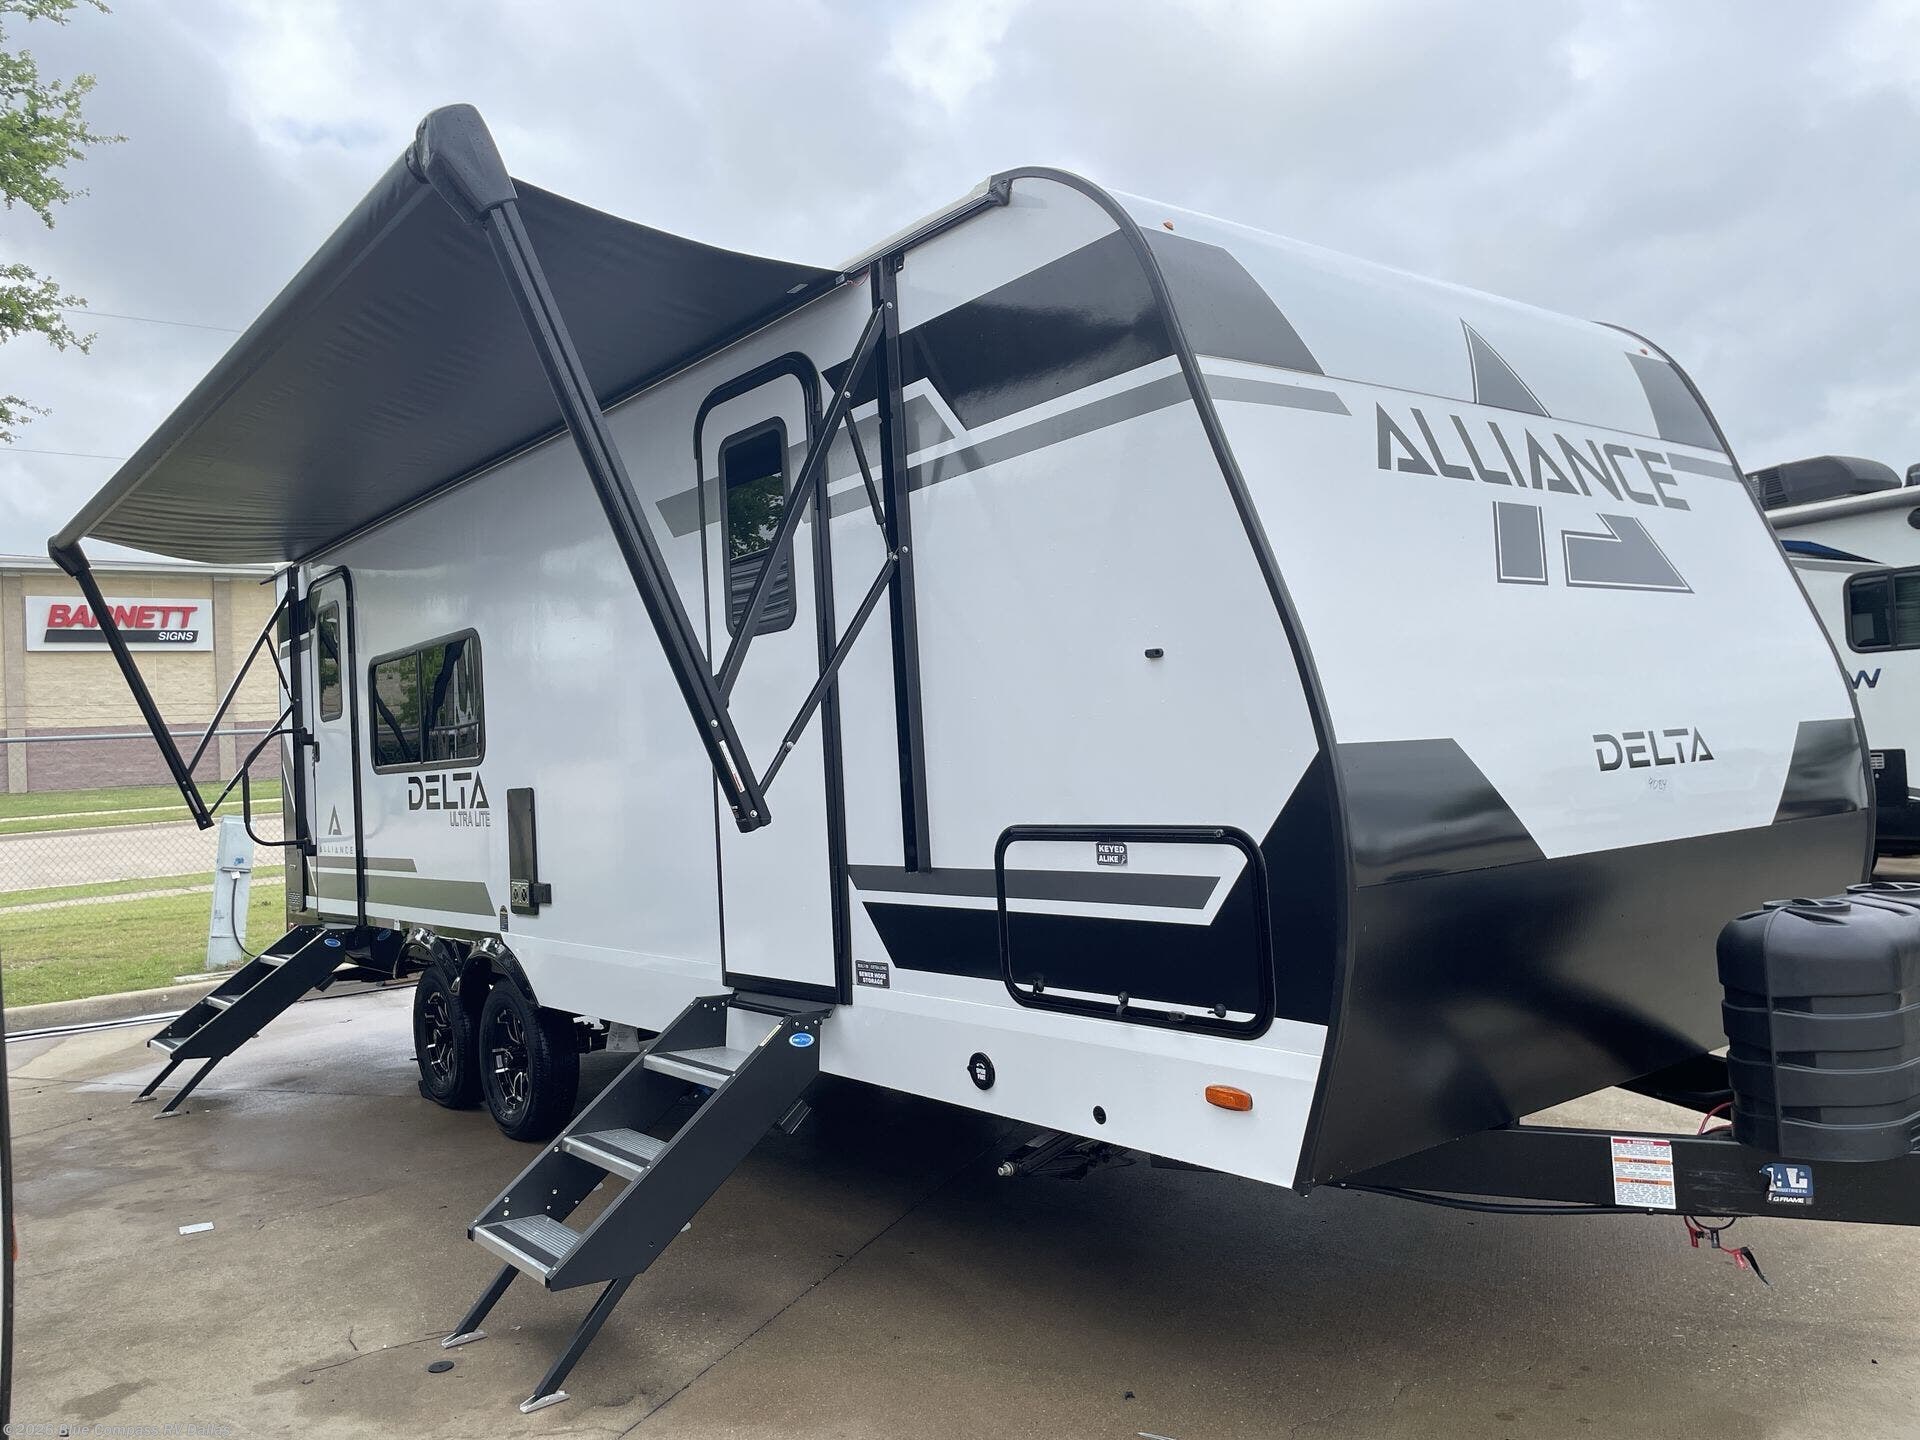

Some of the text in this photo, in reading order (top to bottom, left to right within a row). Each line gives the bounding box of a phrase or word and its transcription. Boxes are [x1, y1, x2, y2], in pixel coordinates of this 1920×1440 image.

[1376, 401, 1691, 511] ALLIANCE
[158, 631, 194, 641] SIGNS
[1592, 726, 1715, 772] DELTA
[408, 770, 490, 811] DELTA
[450, 811, 491, 827] ULTRA LITE
[319, 846, 353, 855] ALLIANCE
[1098, 844, 1125, 853] KEYED
[1098, 855, 1119, 863] ALIKE
